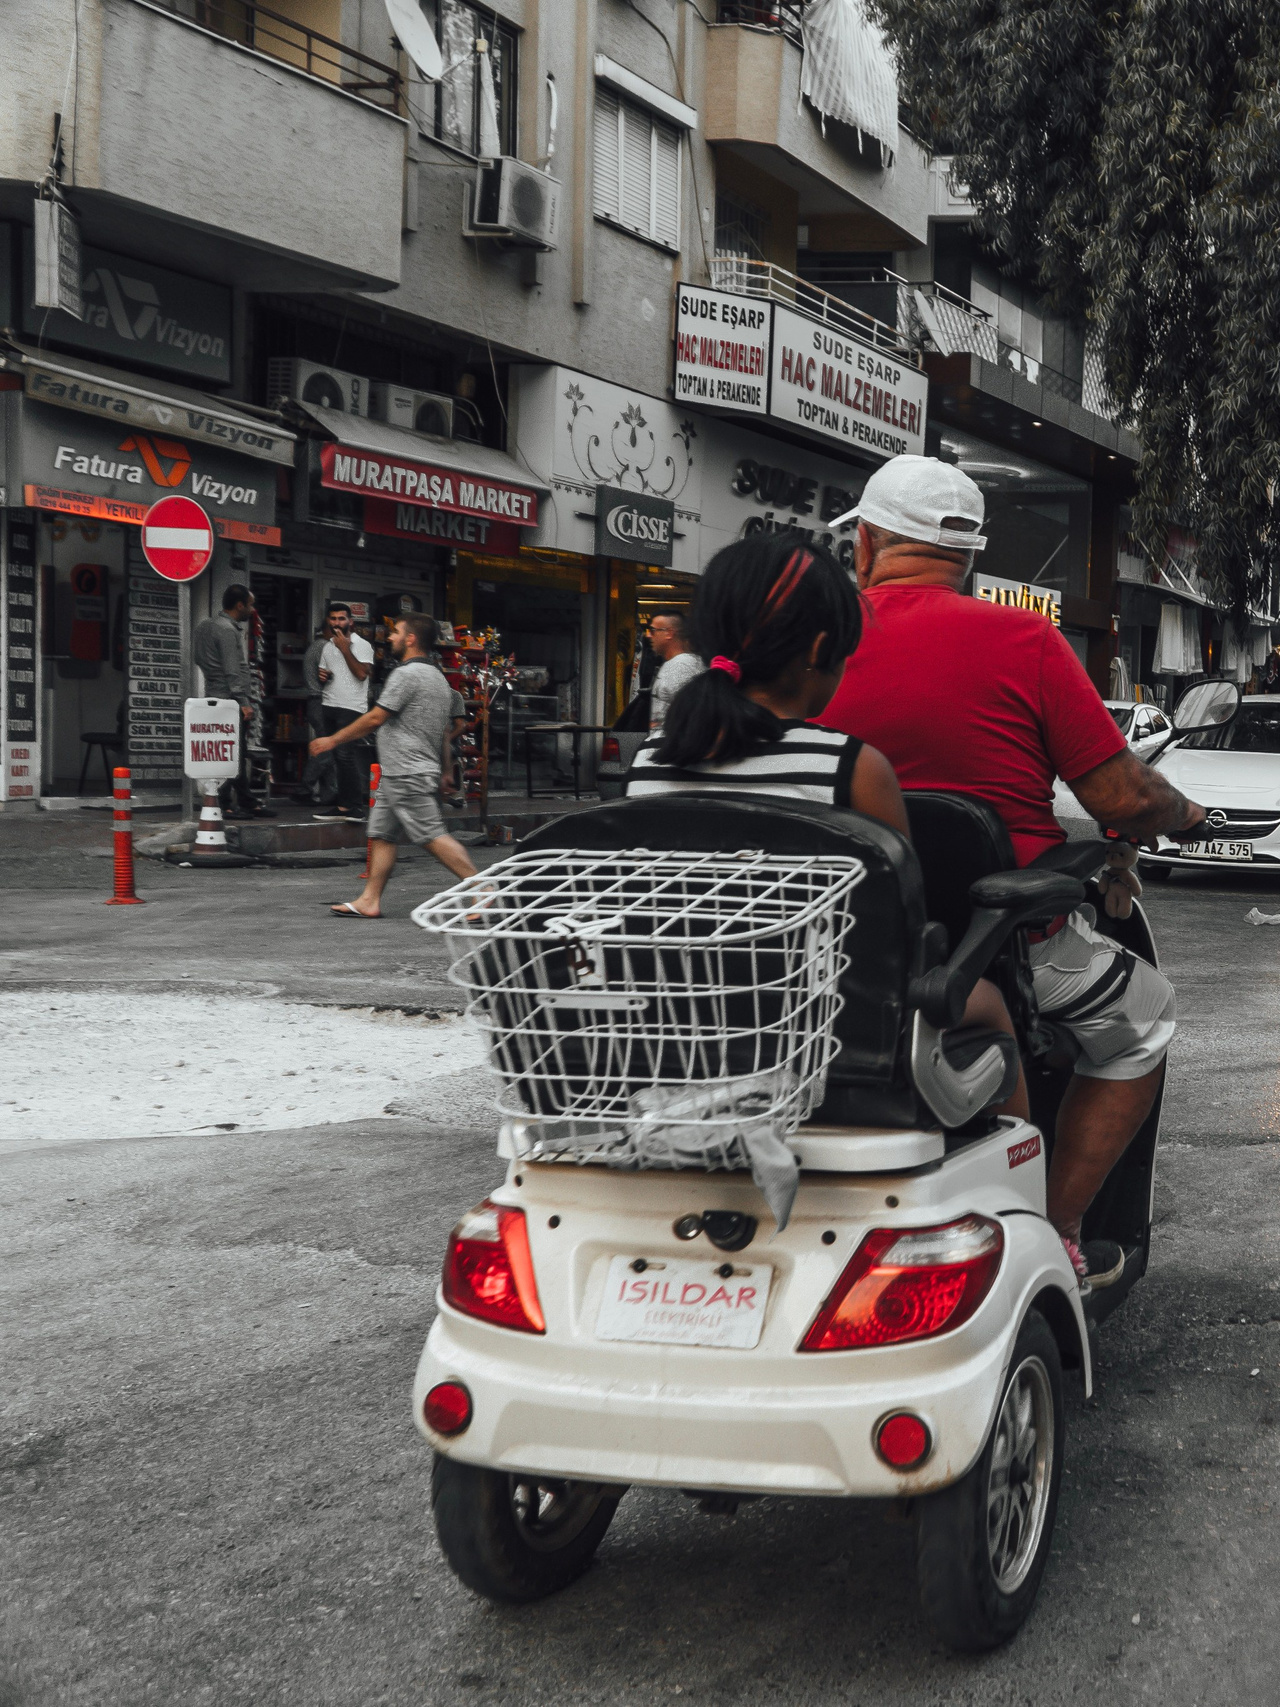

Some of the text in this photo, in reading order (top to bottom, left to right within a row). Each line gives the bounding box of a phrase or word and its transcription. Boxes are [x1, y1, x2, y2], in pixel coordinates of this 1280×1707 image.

[681, 296, 765, 329] SUDE EŞARP
[155, 314, 225, 357] Vizyon
[677, 331, 764, 377] HAC MALZEMELERİ
[813, 331, 901, 386] SUDE EŞARP
[678, 373, 761, 406] TOPTAN & PERAKENDE
[781, 345, 922, 436] HAC MALZEMELERİ
[31, 373, 276, 451] Fatura Vizyon
[797, 398, 908, 454] TOPTAN & PERAKENDE
[54, 446, 258, 505] Fatura Vizyon
[333, 453, 532, 519] MURATPAŞA MARKET
[396, 503, 490, 545] MARKET
[617, 508, 670, 543] CİSSE
[190, 723, 236, 737] MURATPAŞA
[191, 740, 236, 762] MARKET
[1187, 842, 1200, 853] 07
[1204, 841, 1223, 855] AAZ
[1229, 843, 1249, 857] 575
[617, 1279, 758, 1310] ISILDAR
